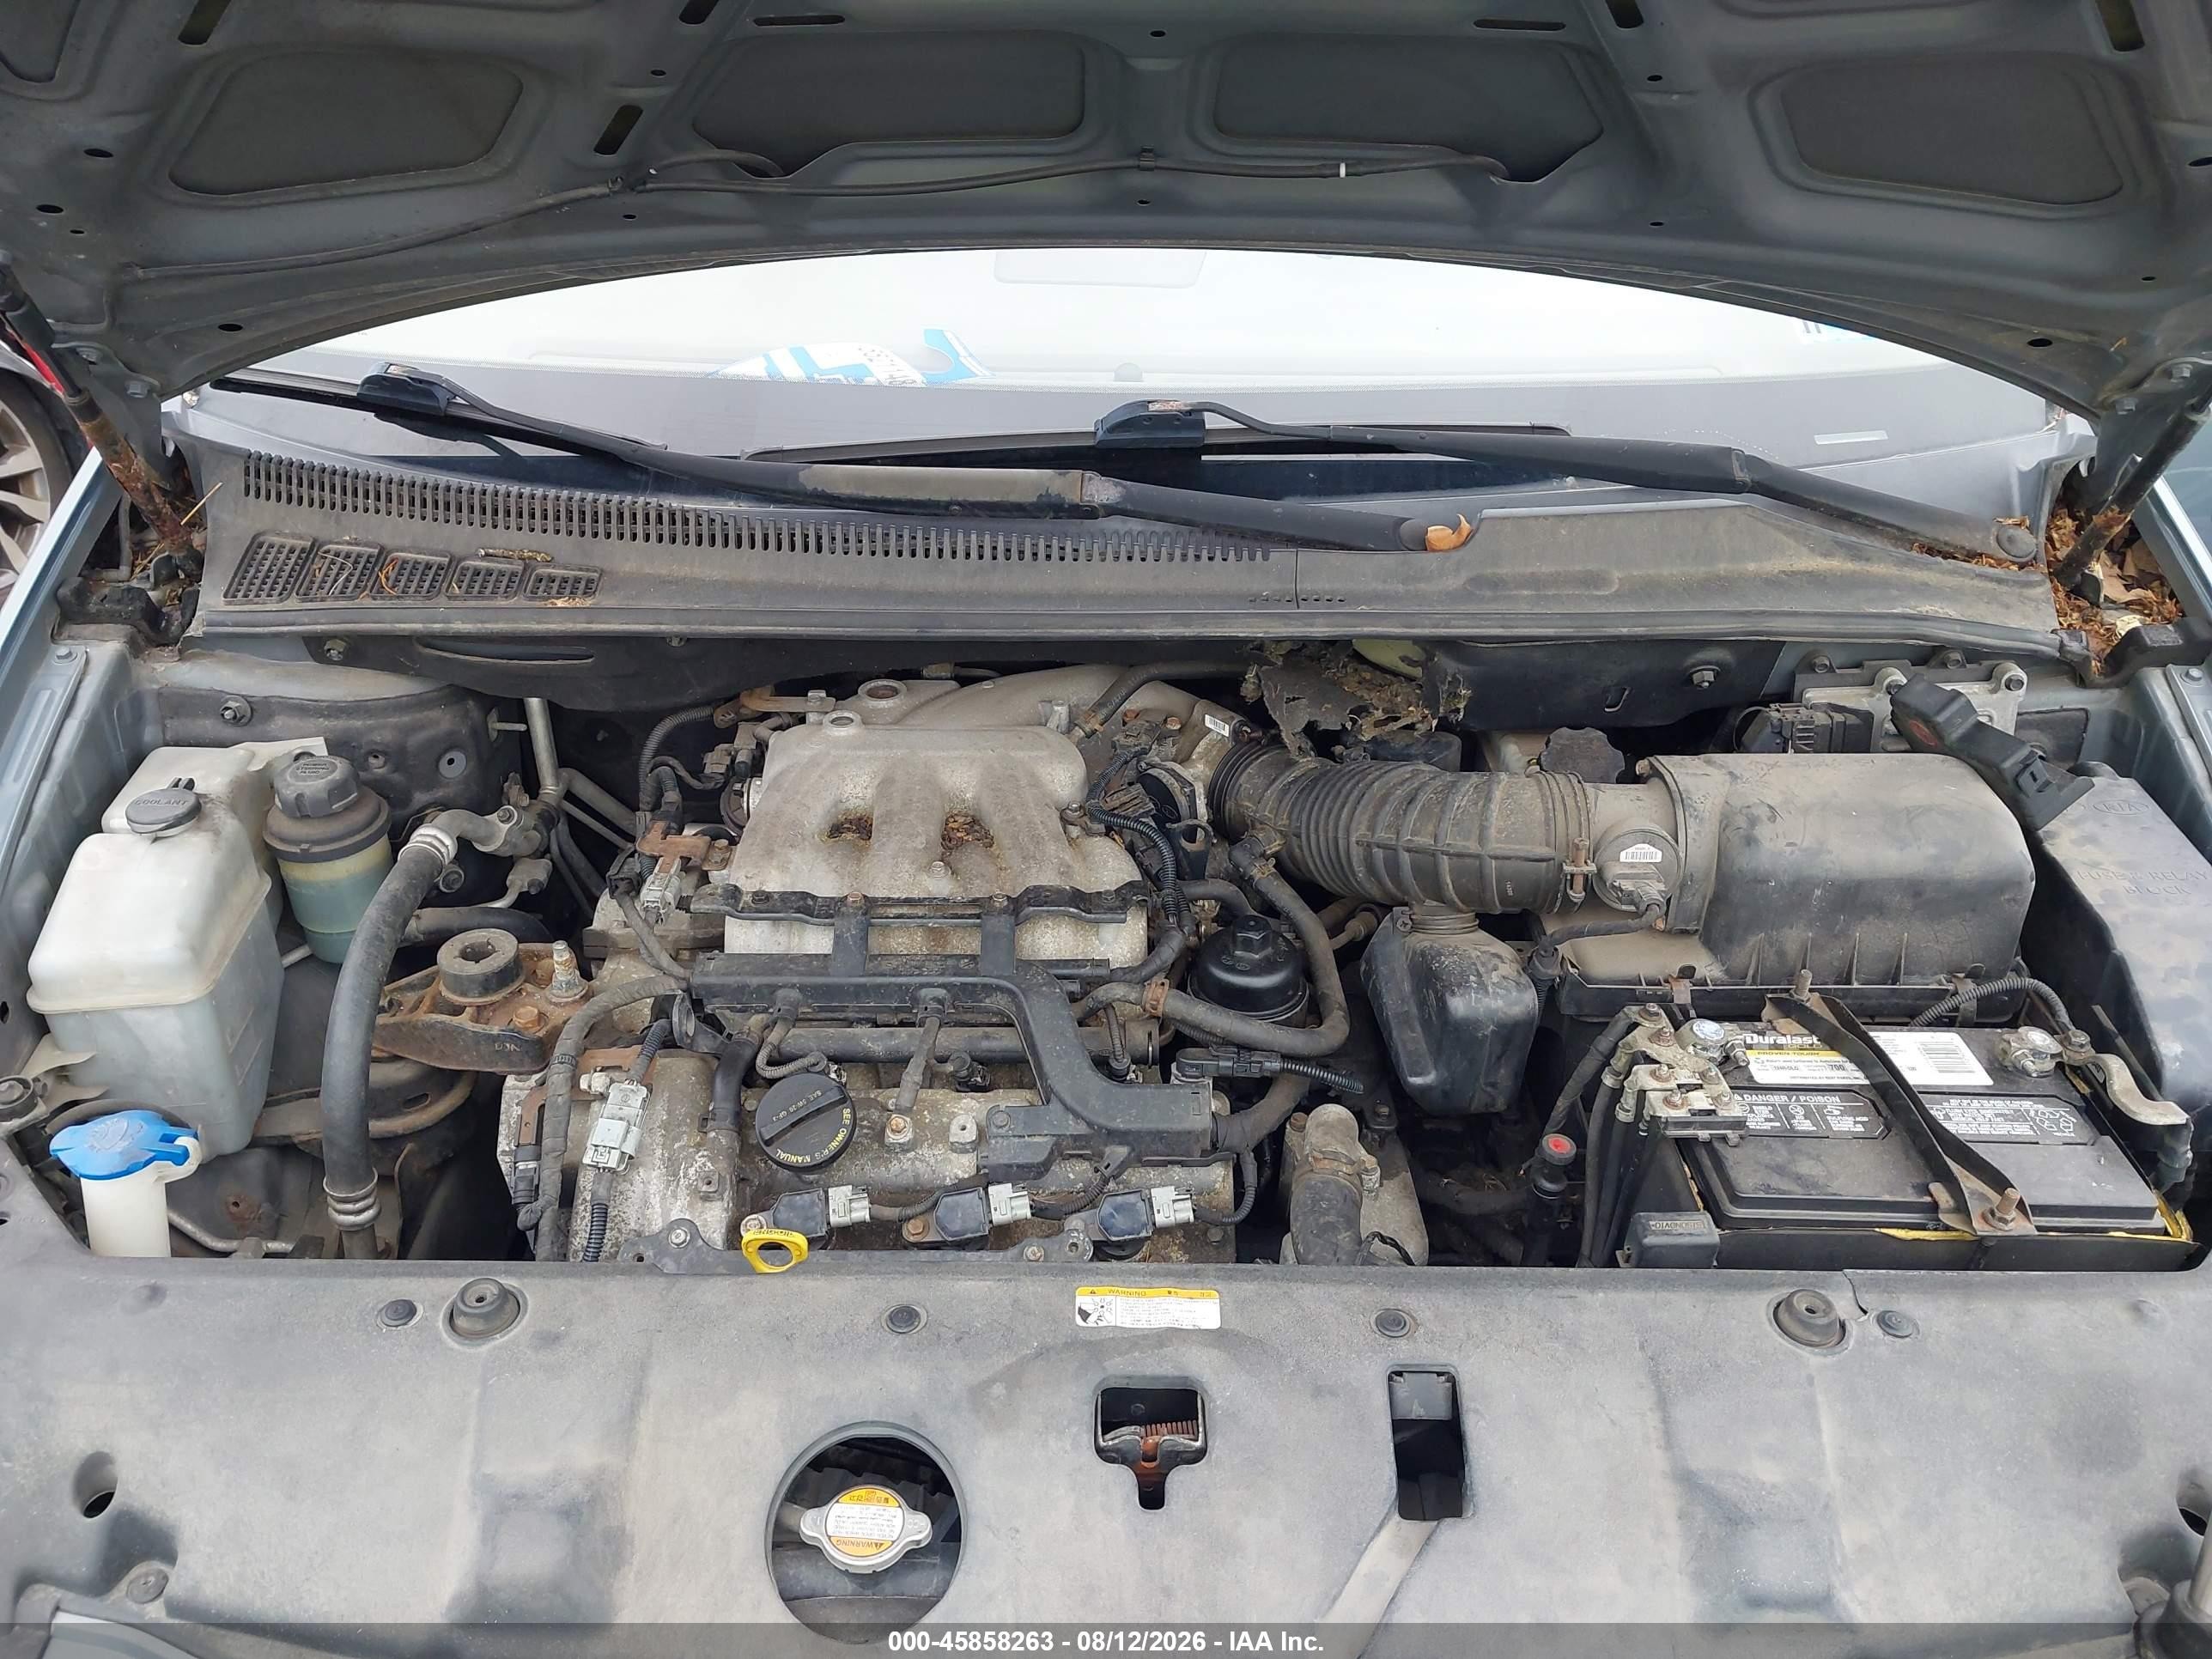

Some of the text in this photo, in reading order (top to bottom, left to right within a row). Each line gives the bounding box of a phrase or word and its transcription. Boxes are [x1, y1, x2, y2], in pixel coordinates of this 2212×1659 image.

[2148, 871, 2208, 881] RELAY
[2123, 885, 2191, 895] BLOCK
[1742, 1033, 1821, 1044] Duralast
[810, 1090, 823, 1101] SAE
[776, 1108, 852, 1164] SEE OWNER'S MANUAL
[836, 1539, 874, 1549] WARNING
